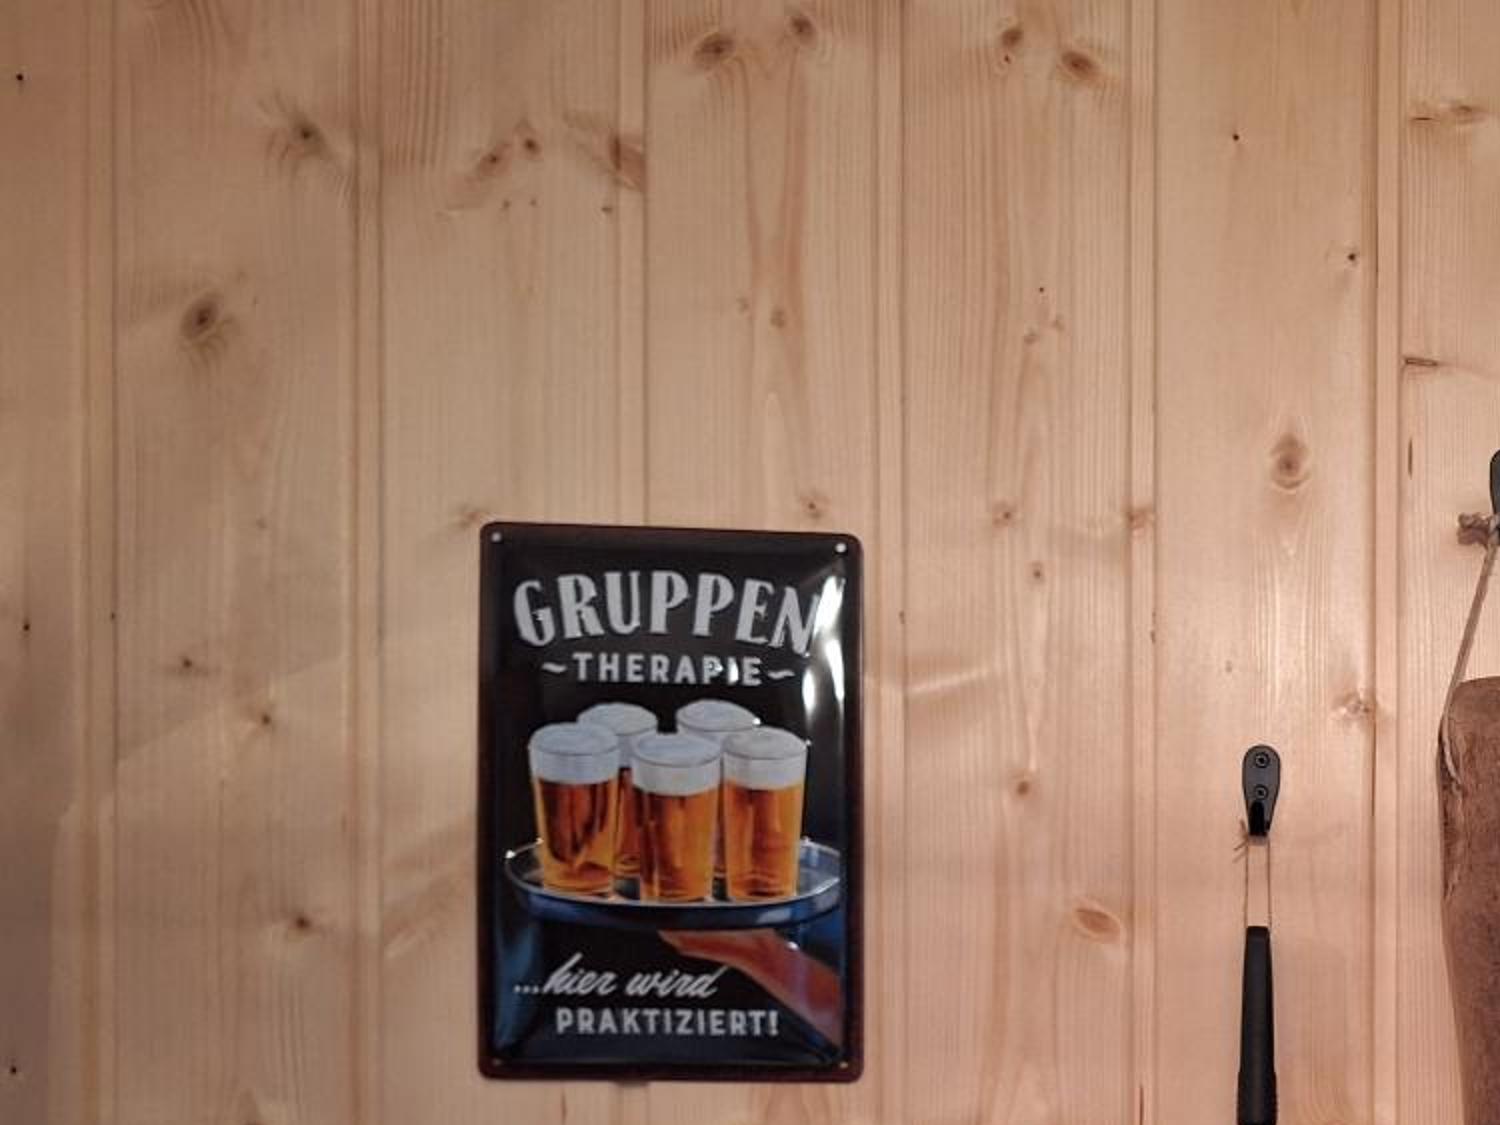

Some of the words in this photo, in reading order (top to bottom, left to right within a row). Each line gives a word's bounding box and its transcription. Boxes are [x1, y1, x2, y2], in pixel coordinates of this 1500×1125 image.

[513, 569, 820, 655] GRUPPEN
[573, 653, 762, 687] THERAPIE
[624, 963, 728, 998] wird
[556, 1007, 779, 1036] PRAKTIZIERT!
